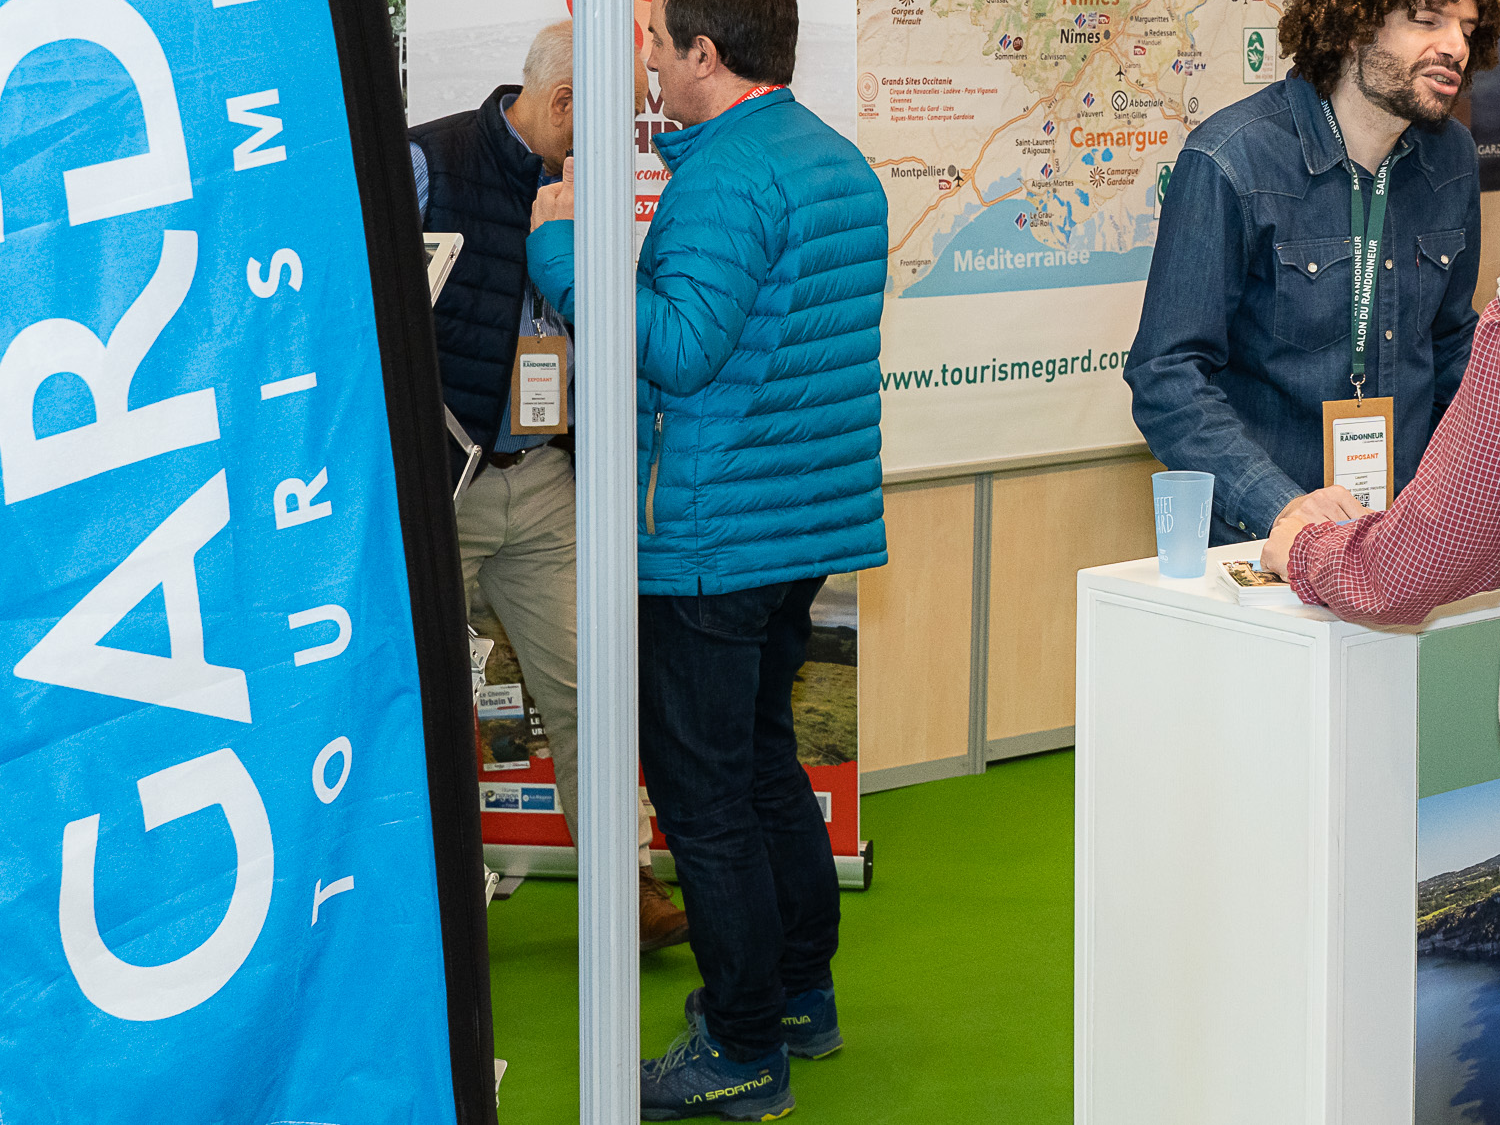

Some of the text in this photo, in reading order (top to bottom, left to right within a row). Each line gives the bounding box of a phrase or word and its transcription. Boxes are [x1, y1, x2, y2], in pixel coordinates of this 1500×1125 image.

[891, 7, 913, 16] Gorges
[892, 17, 921, 25] l'Hérault
[1134, 16, 1169, 24] Marguerittes
[1060, 28, 1100, 44] Nîmes
[995, 53, 1027, 61] Sommières
[1040, 53, 1066, 61] Calvisson
[881, 77, 952, 86] Grands Sites Occitanie
[1129, 99, 1163, 107] Abbatiale
[1080, 110, 1104, 118] Vauvert
[1114, 112, 1147, 120] Saint-Gilles
[1015, 138, 1056, 147] Saint-Laurent-
[1070, 127, 1168, 152] Camargue
[891, 166, 946, 179] Montpellier
[1106, 168, 1138, 176] Camargue
[1106, 177, 1134, 186] Gardoise
[1375, 161, 1388, 195] SALON
[1031, 180, 1074, 188] Aigues-Mortes
[900, 258, 931, 267] Frontignan
[954, 248, 1090, 272] Méditerranée
[1356, 239, 1378, 353] SALON DU RANDONNEUR
[1340, 432, 1383, 441] RANDONNEUR
[1346, 453, 1379, 462] EXPOSANT
[488, 690, 510, 698] Chemin
[480, 697, 513, 706] Urbain V
[685, 1074, 773, 1104] LA SPORTIVA
